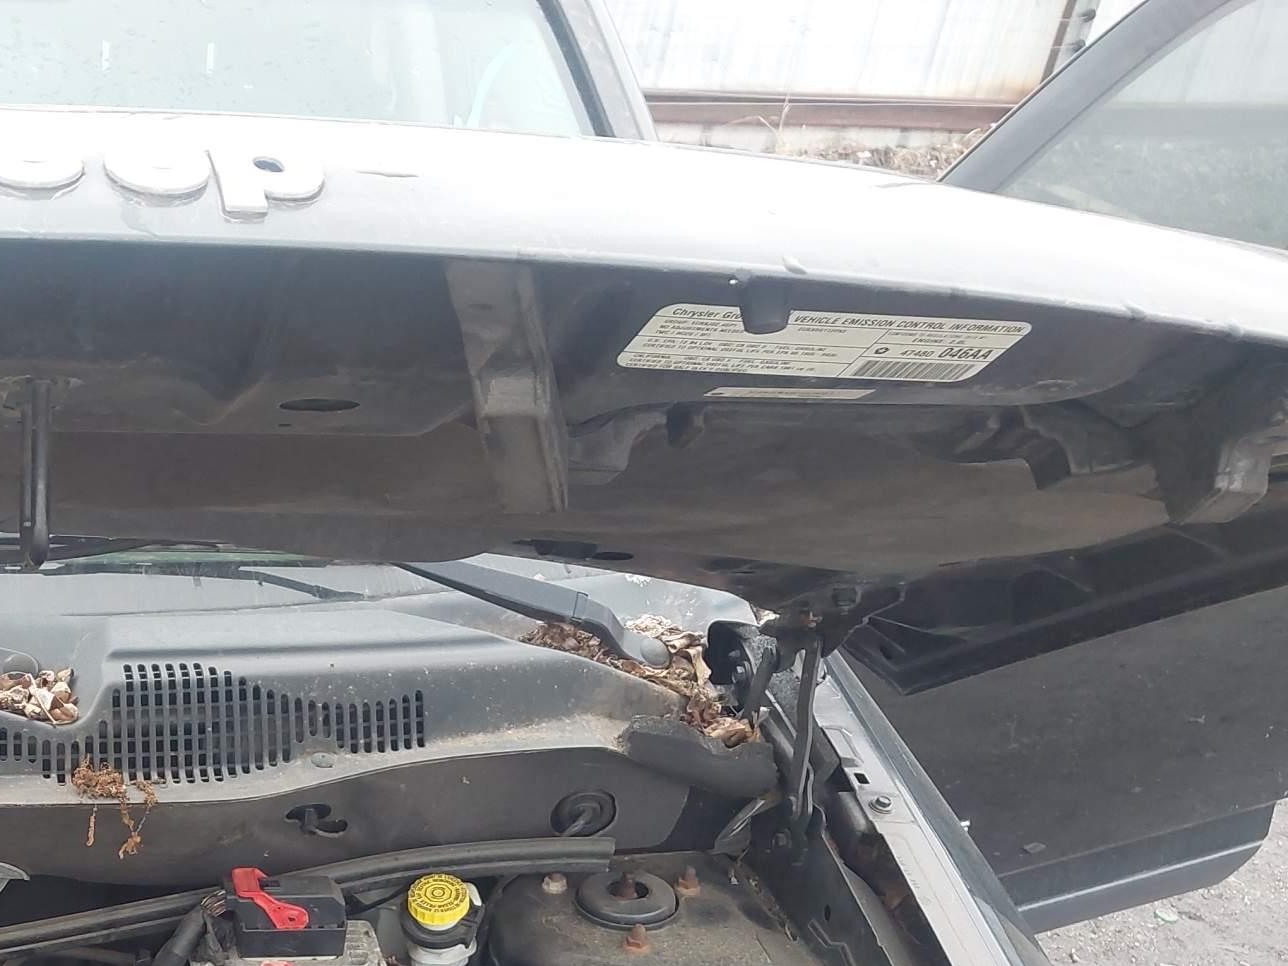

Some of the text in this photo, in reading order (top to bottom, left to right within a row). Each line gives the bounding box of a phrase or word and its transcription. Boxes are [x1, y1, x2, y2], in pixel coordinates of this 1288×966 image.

[673, 307, 744, 320] Chrysler Gro
[793, 314, 1026, 333] VEHICLE EMISSION CONTROL INFORMATION
[937, 347, 993, 360] 046AA
